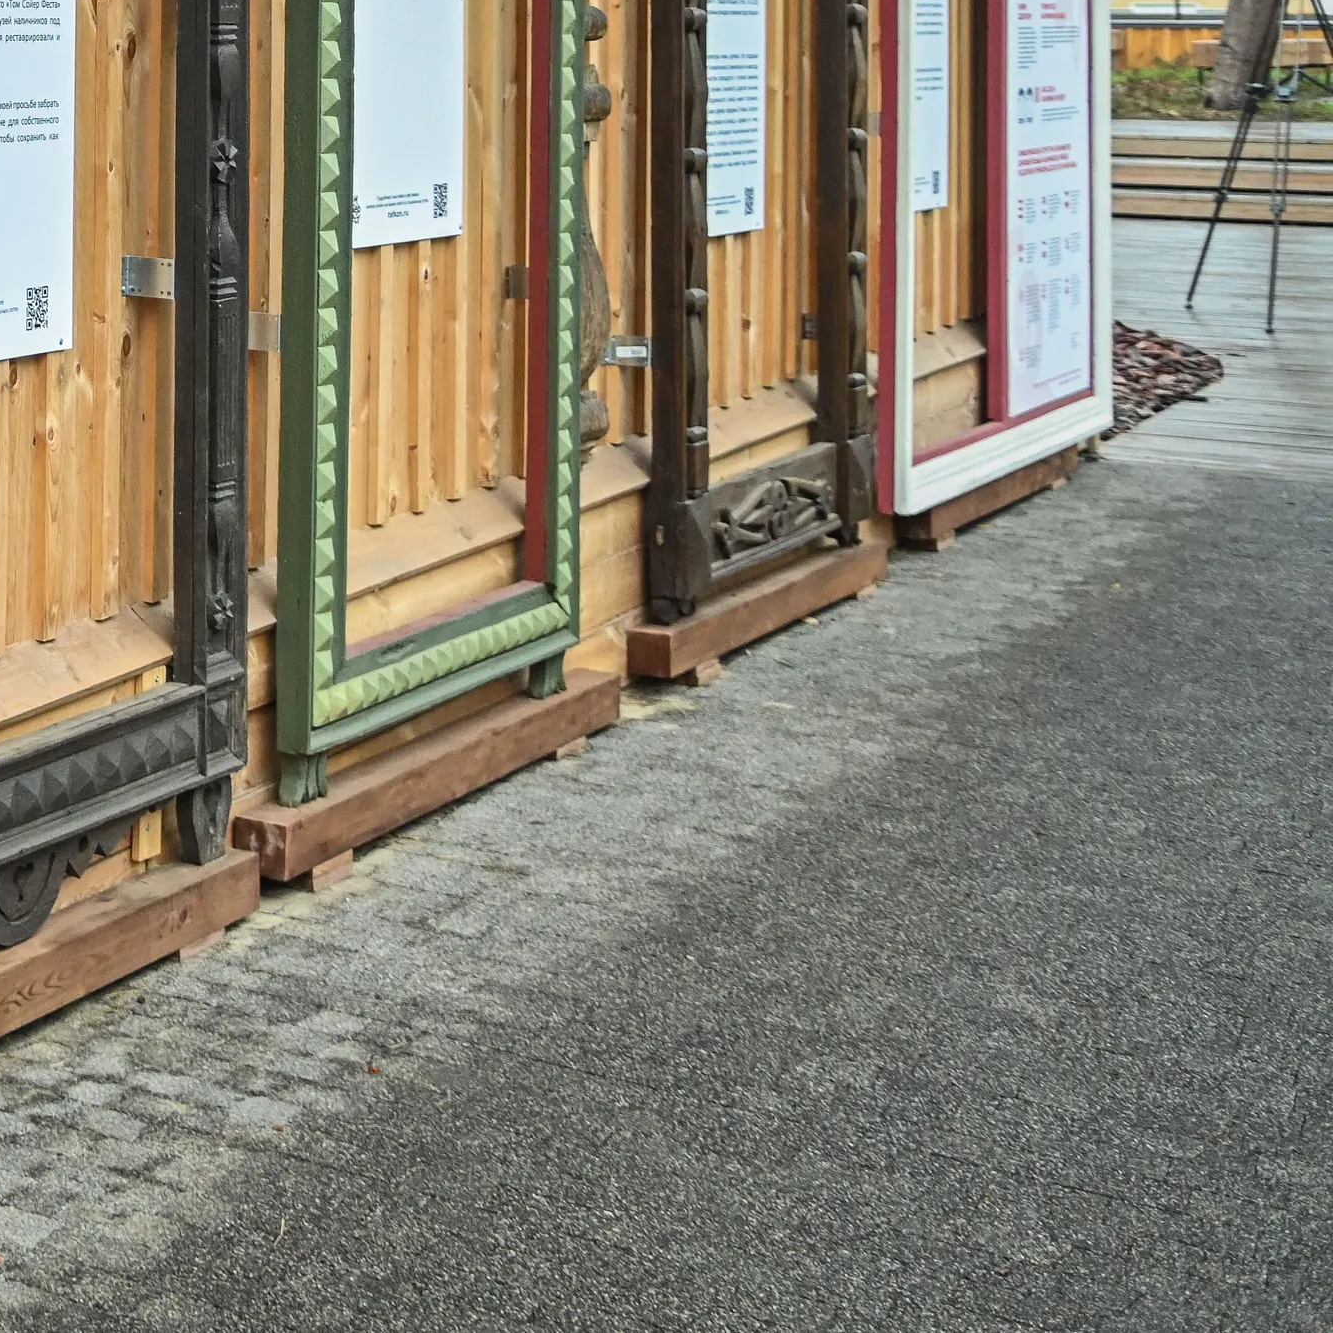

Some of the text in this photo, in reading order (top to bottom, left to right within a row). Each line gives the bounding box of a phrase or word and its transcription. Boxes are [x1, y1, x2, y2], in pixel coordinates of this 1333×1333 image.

[22, 0, 39, 9] Сойер
[50, 18, 60, 26] под
[6, 34, 53, 43] реставрировали
[13, 99, 36, 110] просьбе
[38, 99, 59, 109] забрать
[8, 118, 19, 127] для
[21, 116, 59, 125] собственного
[17, 133, 46, 143] сохранить
